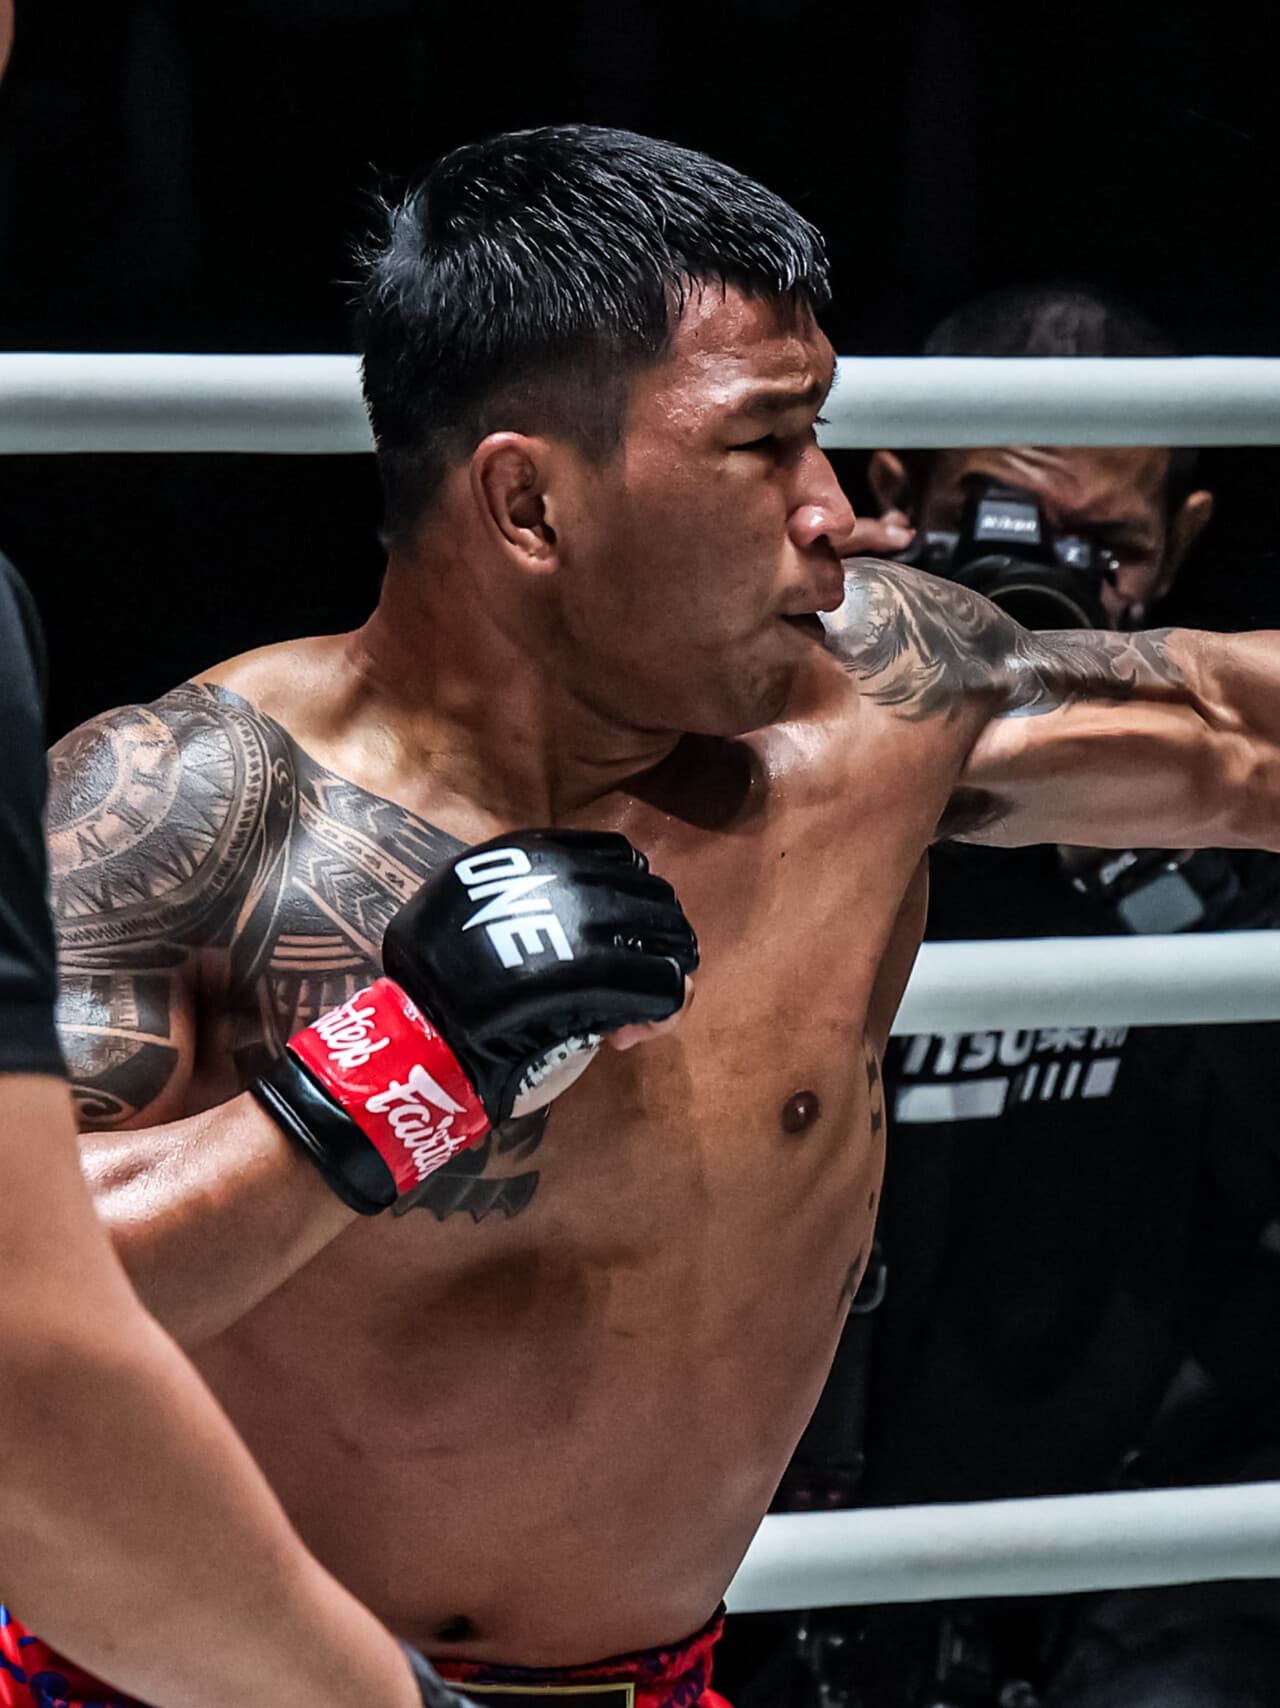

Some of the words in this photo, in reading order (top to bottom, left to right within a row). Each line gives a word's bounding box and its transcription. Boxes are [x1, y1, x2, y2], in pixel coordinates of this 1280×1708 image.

[981, 514, 1038, 533] Nikon
[453, 846, 575, 969] ONE
[364, 1063, 468, 1182] Fairte
